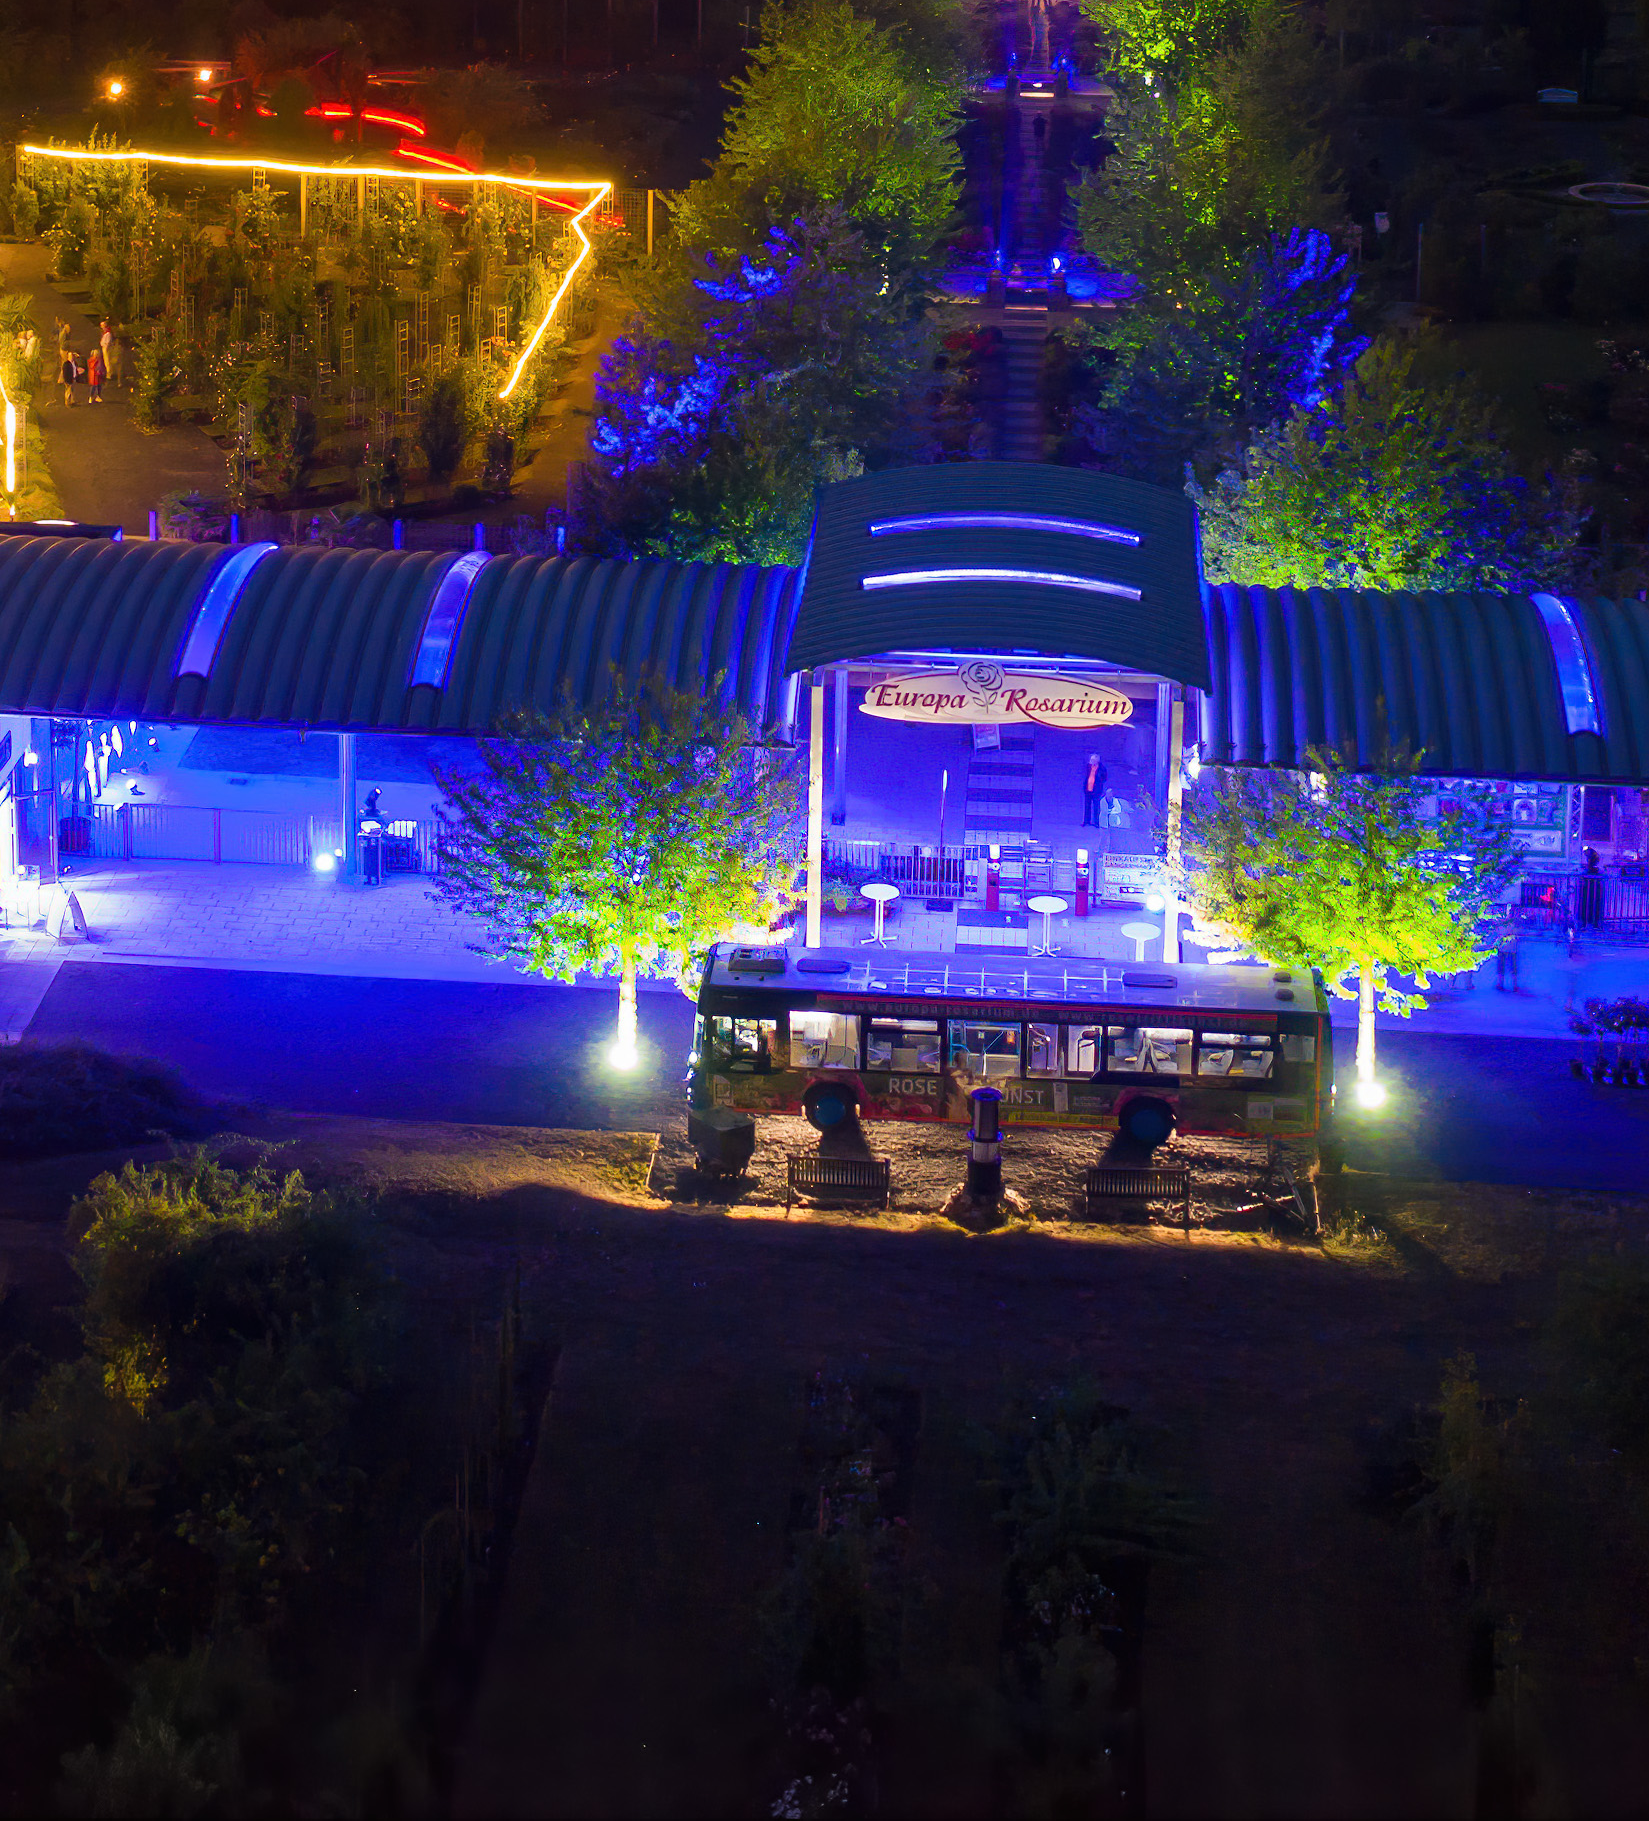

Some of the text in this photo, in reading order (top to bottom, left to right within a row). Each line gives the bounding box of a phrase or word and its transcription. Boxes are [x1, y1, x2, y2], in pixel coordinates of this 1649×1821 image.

[870, 683, 1133, 723] Europa Rosarium
[888, 1077, 938, 1096] ROSE
